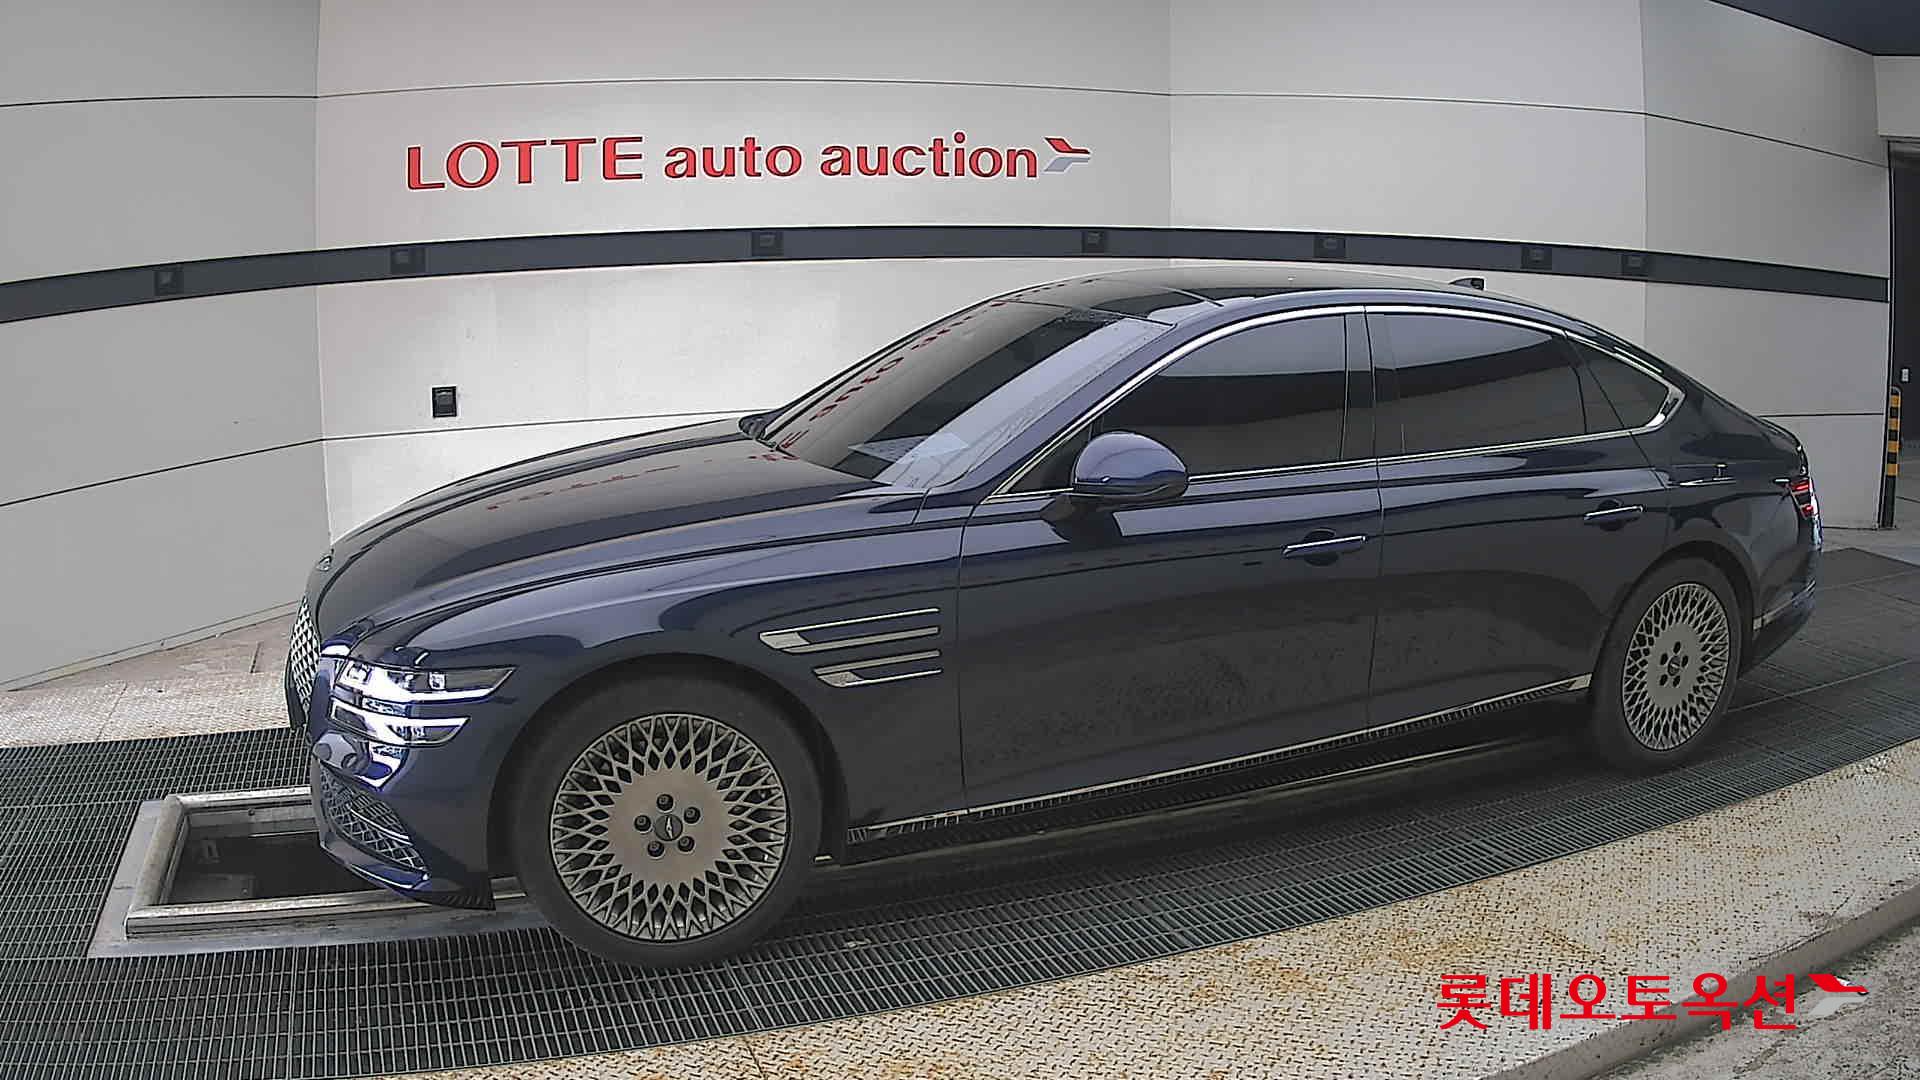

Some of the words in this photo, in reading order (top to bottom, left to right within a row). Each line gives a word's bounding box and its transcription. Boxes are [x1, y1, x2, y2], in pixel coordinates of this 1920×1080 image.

[406, 136, 643, 190] LOTTE
[664, 136, 802, 178] auto
[819, 132, 1038, 178] auction
